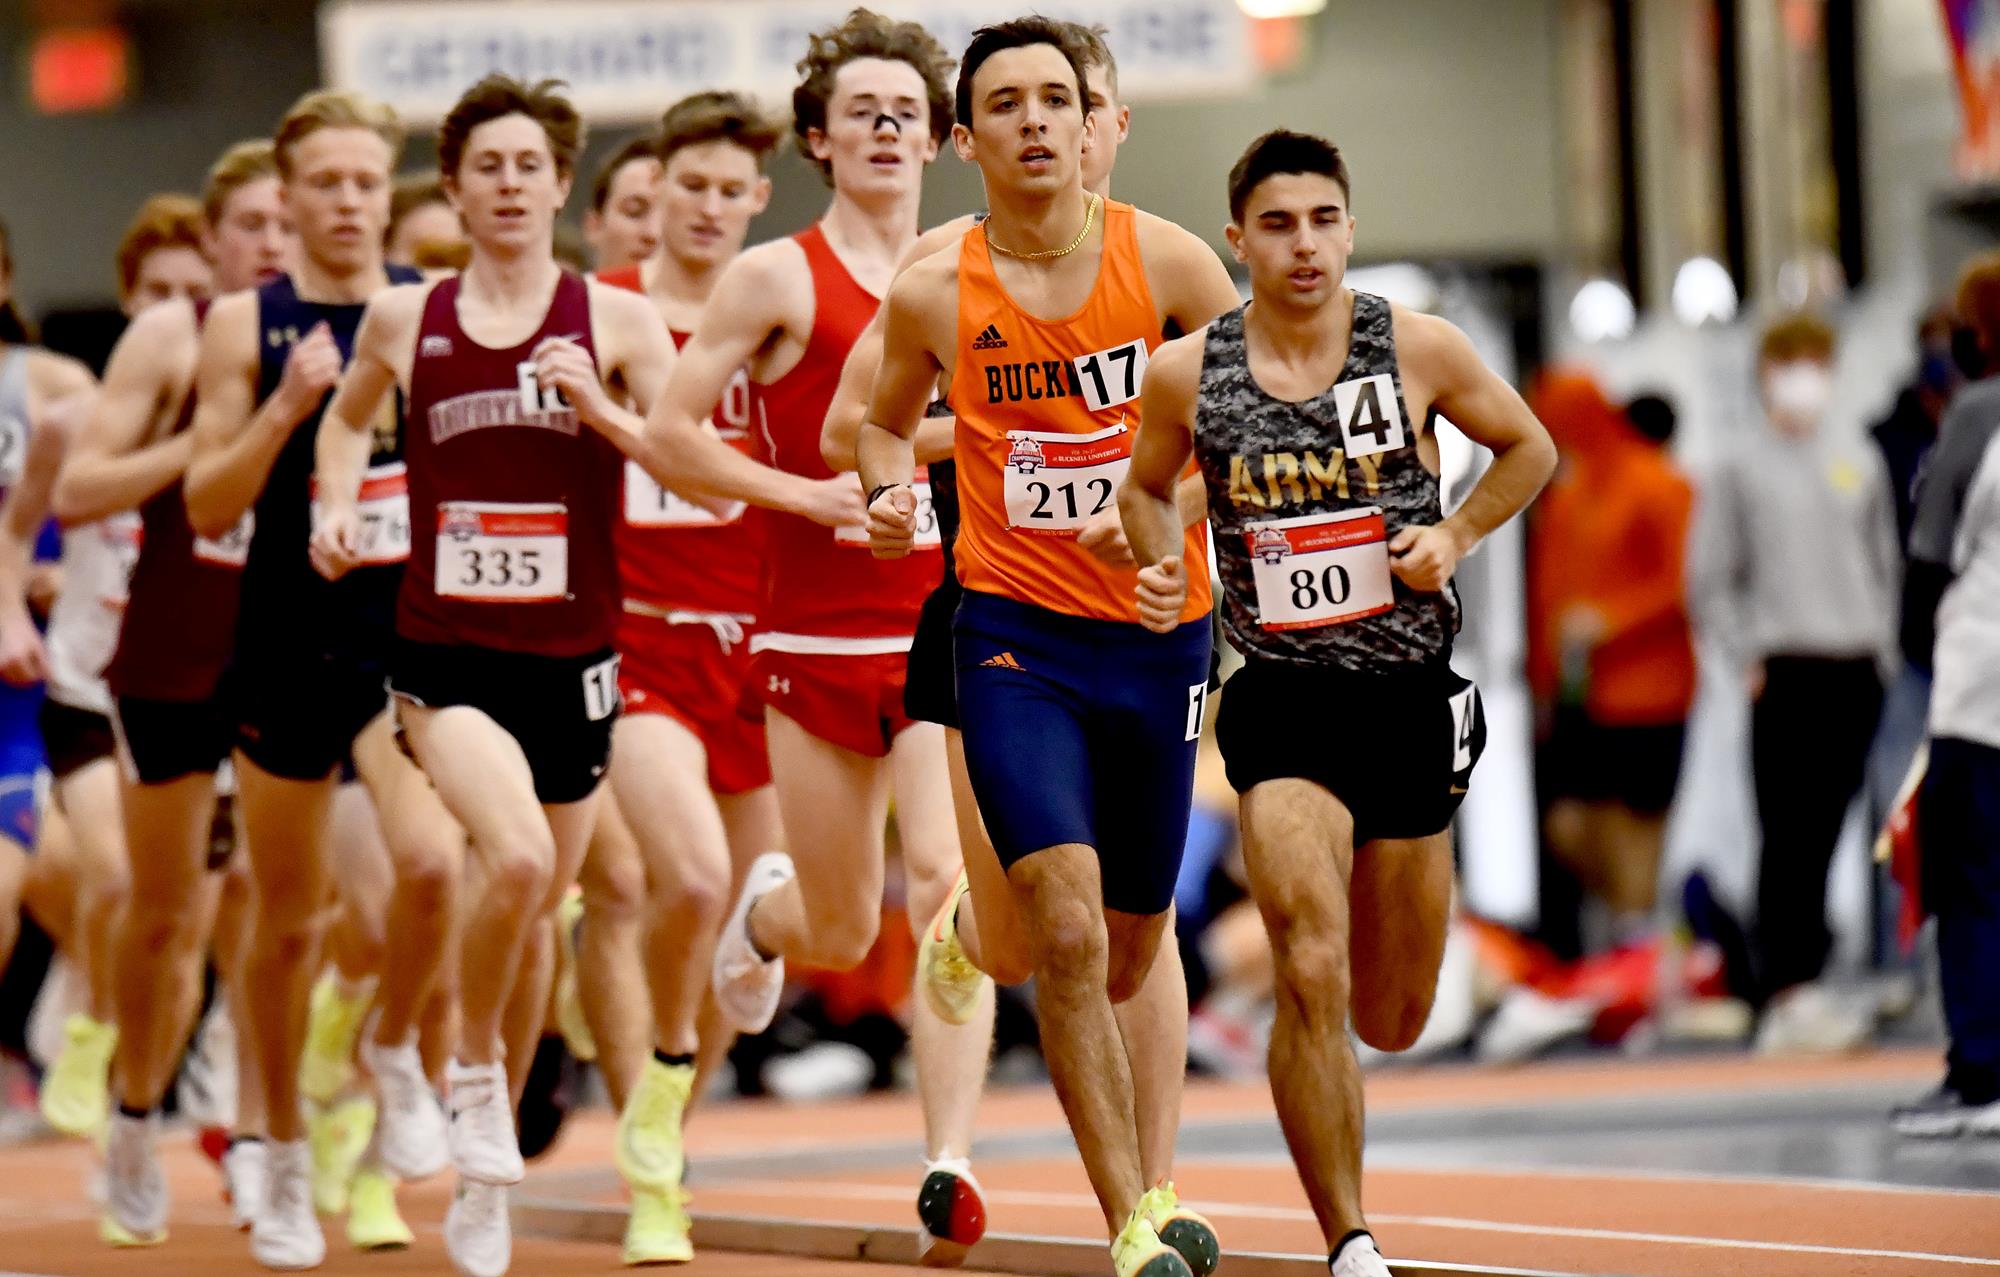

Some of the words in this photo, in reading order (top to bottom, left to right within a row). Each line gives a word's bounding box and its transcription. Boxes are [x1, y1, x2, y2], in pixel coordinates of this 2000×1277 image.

[972, 339, 1008, 350] adidas
[984, 360, 1084, 404] BUCKN
[1080, 344, 1137, 406] 17
[1348, 381, 1392, 446] 4
[1088, 447, 1121, 460] UNIVERSITY
[1026, 478, 1114, 519] 212
[1229, 447, 1385, 508] ARMY
[459, 549, 541, 587] 335
[1290, 564, 1351, 610] 80
